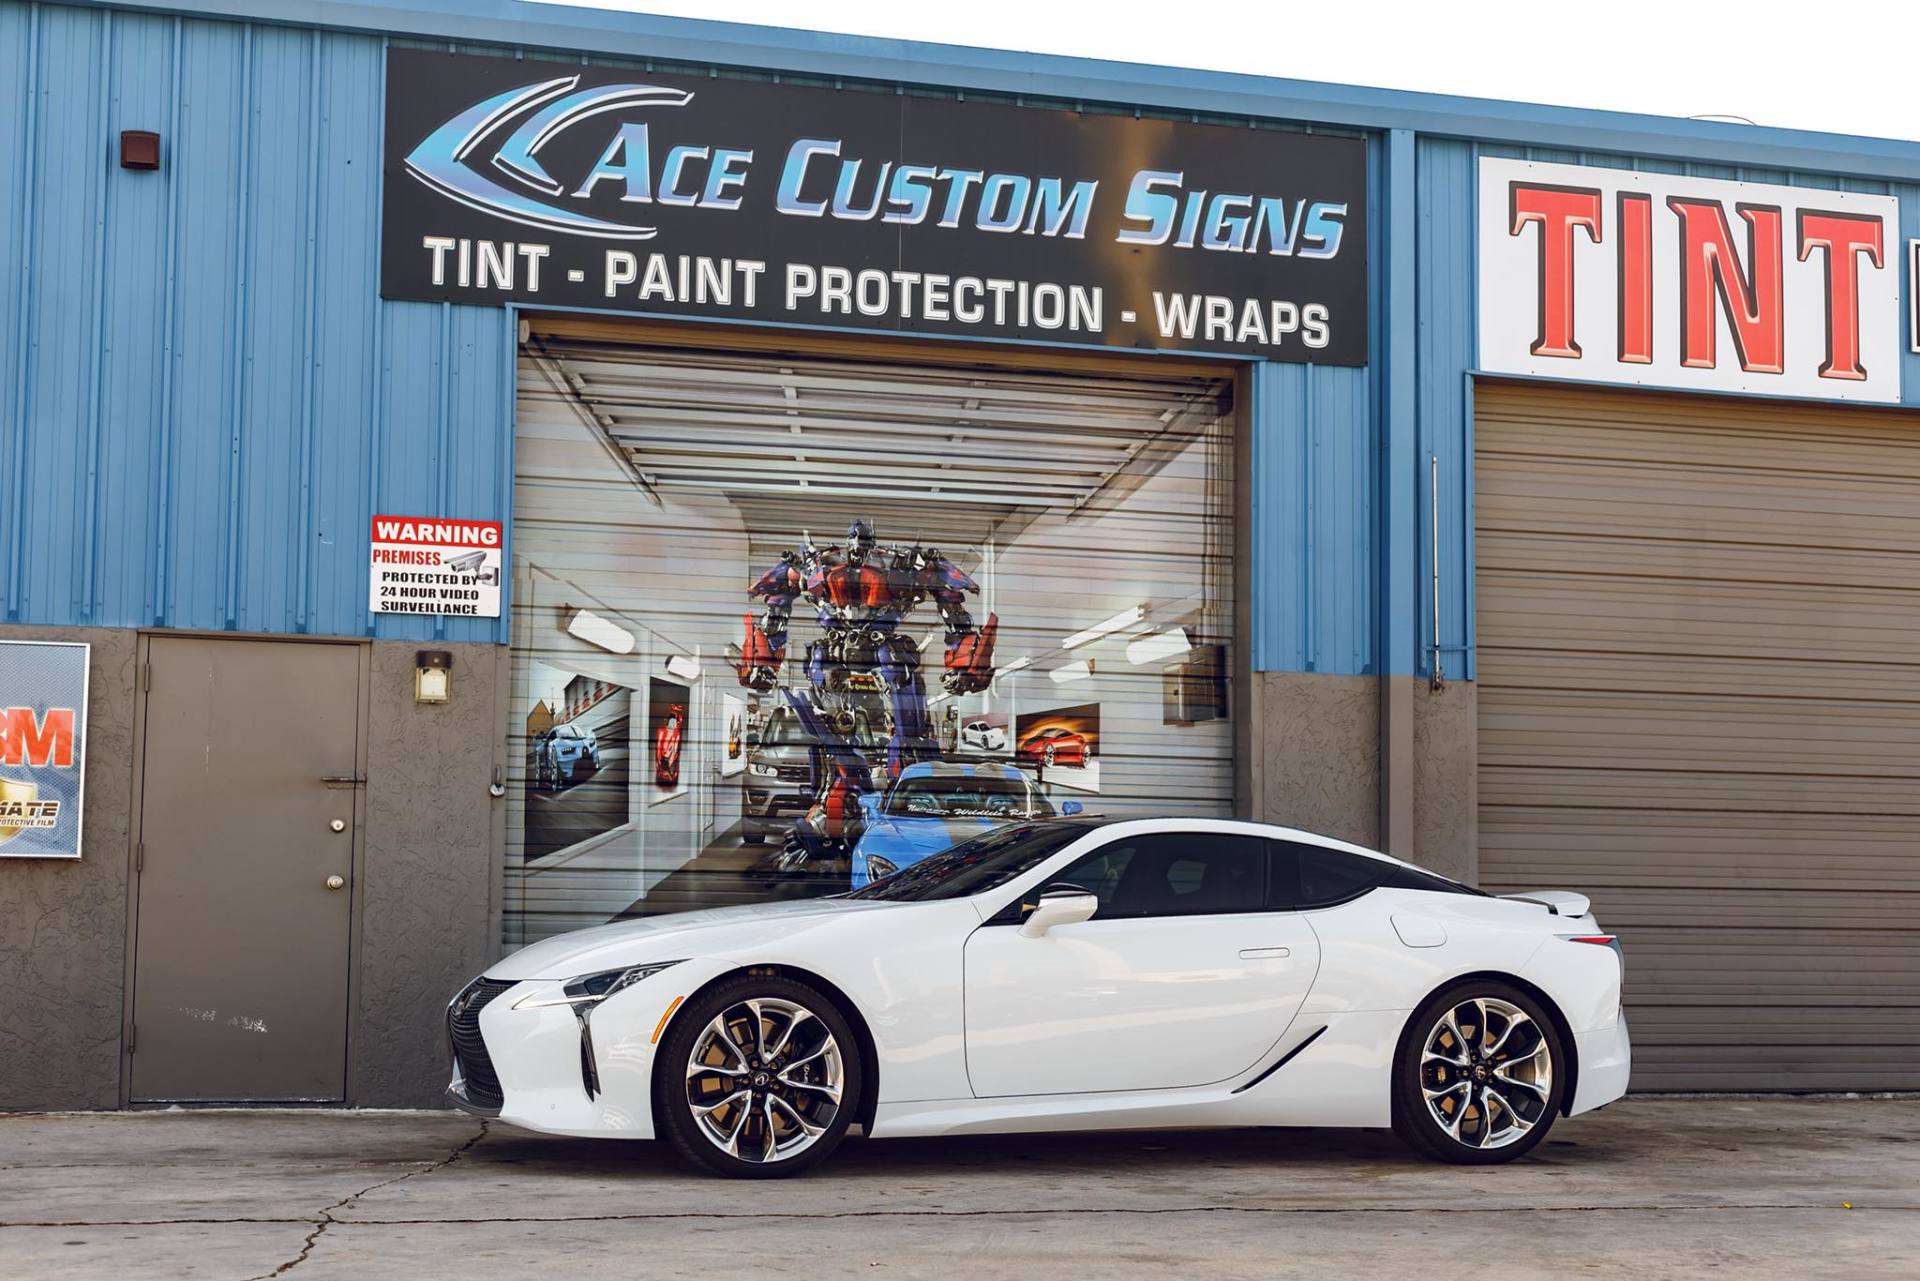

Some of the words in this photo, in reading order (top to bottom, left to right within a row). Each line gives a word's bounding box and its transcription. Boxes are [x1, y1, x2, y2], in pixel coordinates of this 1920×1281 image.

[571, 122, 753, 210] ACE
[775, 139, 1098, 239] CUSTOM
[1115, 170, 1347, 260] SIGNS
[423, 236, 550, 292] TINT
[605, 250, 765, 308] PAINT
[785, 263, 1103, 332] PROTECTION
[1153, 291, 1330, 348] WRAPS
[1509, 180, 1884, 381] TINT
[377, 521, 498, 545] WARNING
[373, 549, 441, 565] PREMISES
[382, 571, 458, 585] PROTECTED
[461, 575, 478, 585] BY
[380, 586, 397, 597] 24
[400, 587, 436, 598] HOUR
[440, 589, 479, 600] VIDEO
[381, 601, 478, 614] SURVEILLANCE
[0, 706, 74, 767] M
